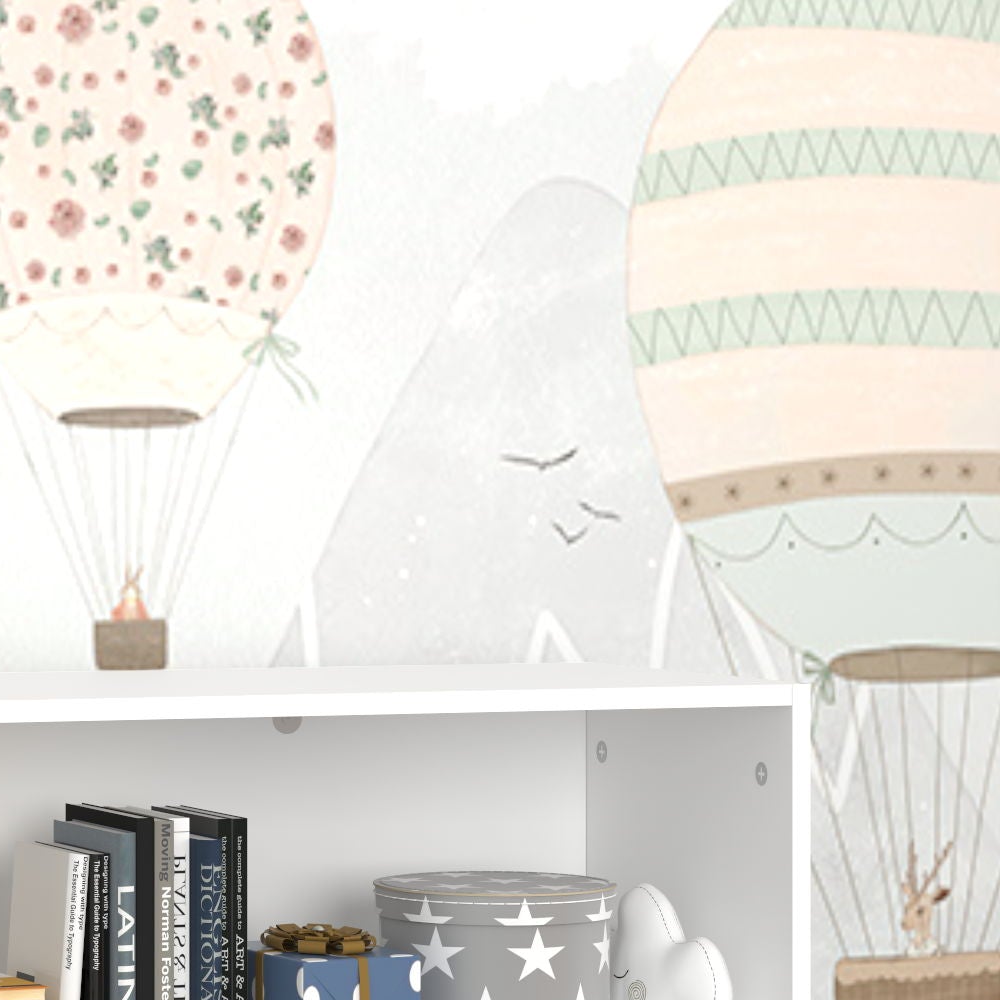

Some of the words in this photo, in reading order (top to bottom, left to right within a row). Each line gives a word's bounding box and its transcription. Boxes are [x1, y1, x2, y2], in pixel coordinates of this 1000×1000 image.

[158, 823, 171, 882] Moving
[72, 860, 80, 873] The
[79, 856, 89, 894] Designing
[93, 860, 101, 872] The
[235, 851, 243, 893] complete
[70, 873, 79, 903] Essential
[93, 873, 101, 903] Essential
[68, 904, 77, 923] Guide
[93, 904, 101, 924] Guide
[161, 886, 172, 952] Norman
[235, 894, 243, 919] guide
[68, 924, 75, 932] to
[77, 913, 86, 931] type
[93, 924, 101, 932] to
[236, 920, 243, 931] to
[65, 932, 75, 970] Typography
[91, 932, 101, 971] Typography
[235, 933, 245, 971] ART
[235, 974, 245, 990] &
